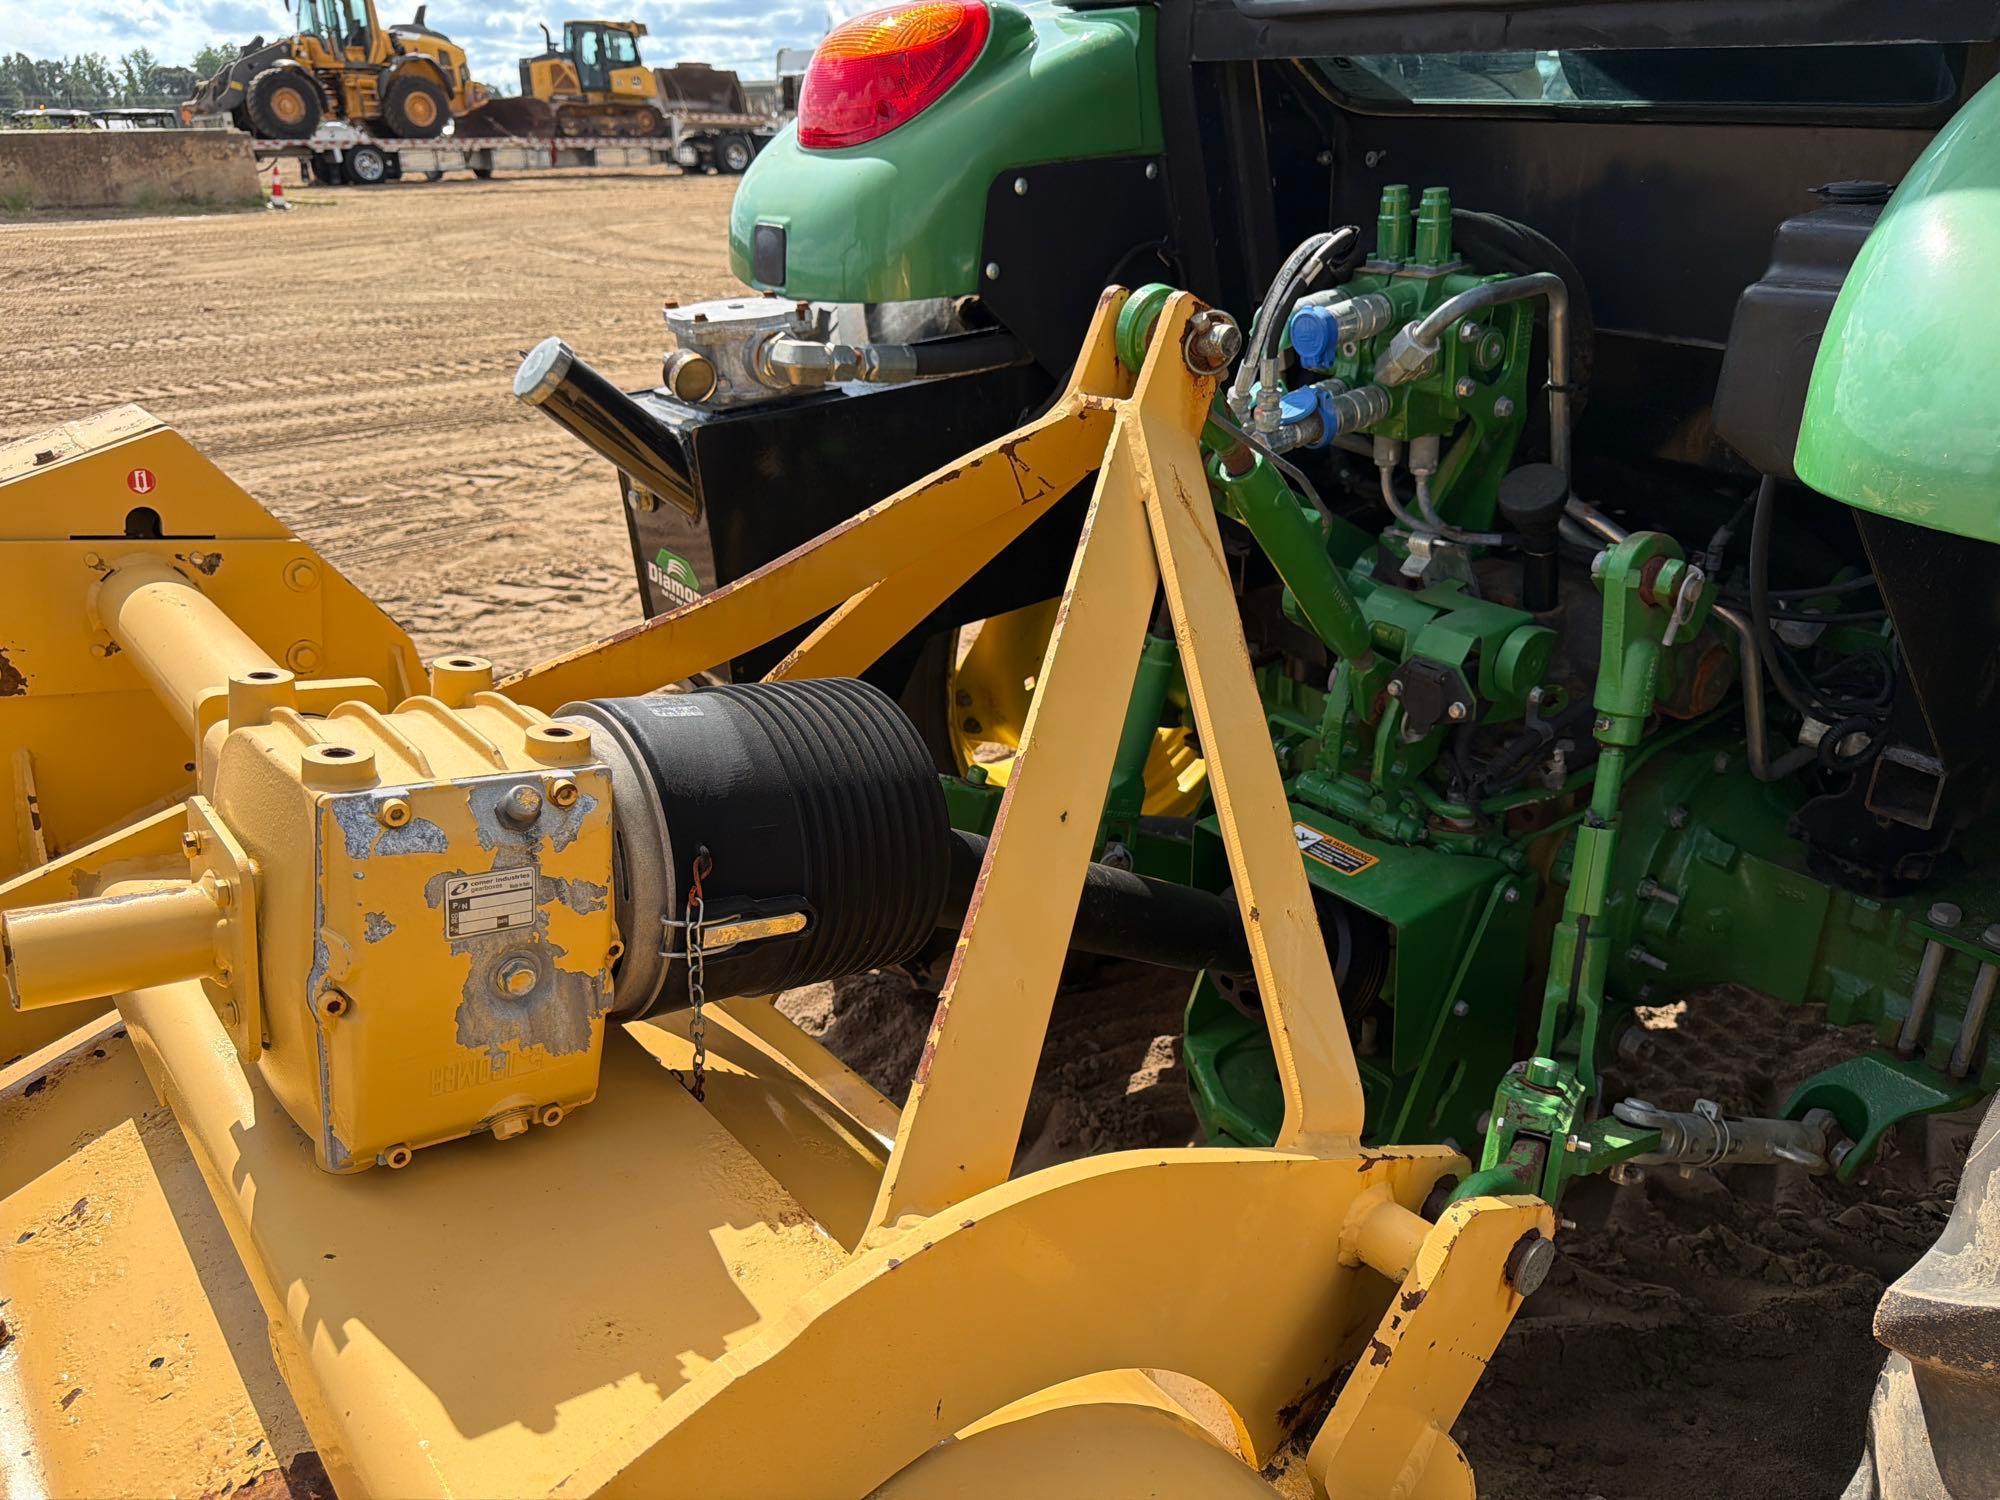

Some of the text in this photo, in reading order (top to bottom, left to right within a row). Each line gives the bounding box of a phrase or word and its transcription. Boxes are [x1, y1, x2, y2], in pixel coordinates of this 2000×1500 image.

[647, 561, 702, 604] Diamon
[1332, 841, 1373, 862] WARNING
[470, 873, 530, 887] comer industries
[470, 884, 502, 893] gearboxes
[452, 902, 468, 910] P/N
